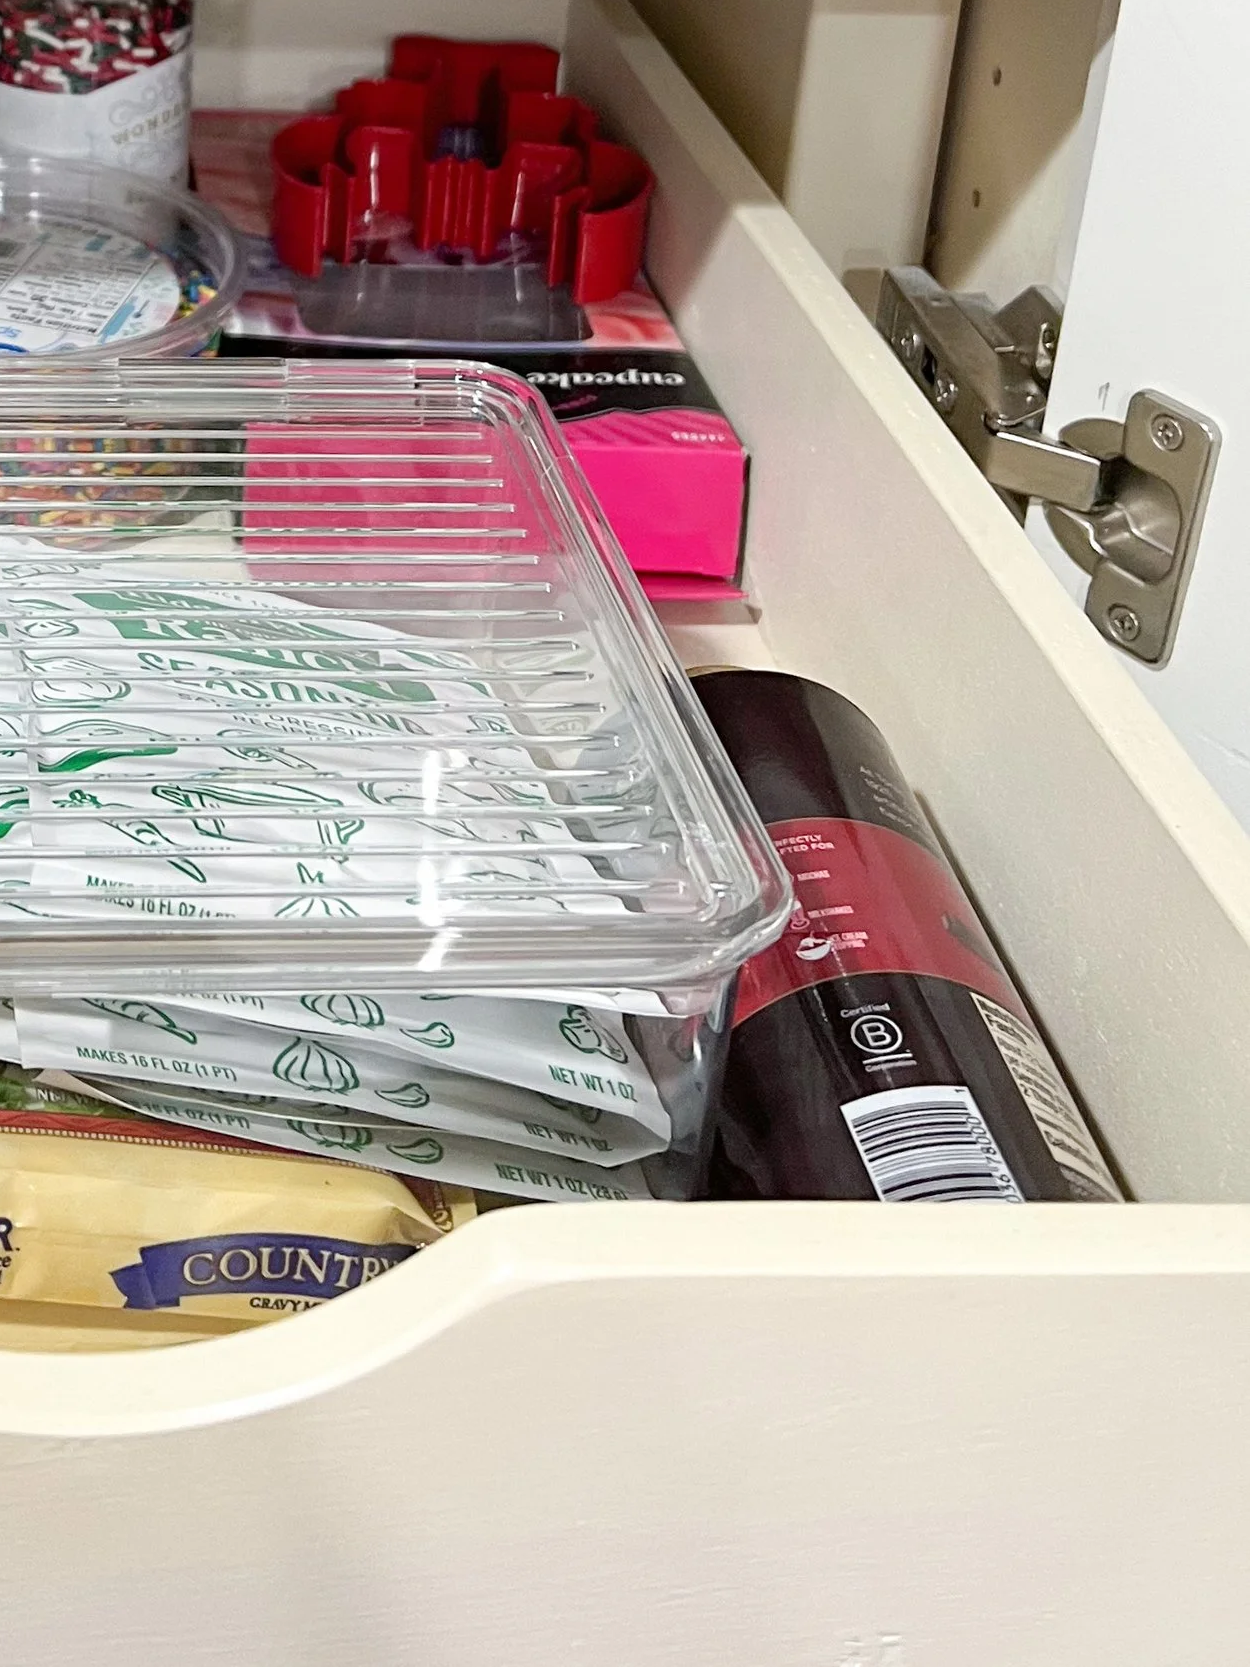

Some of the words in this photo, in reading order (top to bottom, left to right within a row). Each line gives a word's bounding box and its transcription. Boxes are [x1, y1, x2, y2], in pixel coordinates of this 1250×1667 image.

[525, 368, 687, 391] cupcake
[811, 842, 835, 851] FOR
[861, 1022, 892, 1047] B
[76, 1046, 128, 1065] MAKES
[131, 1054, 148, 1068] 16
[151, 1057, 170, 1072] FL
[172, 1059, 193, 1074] OZ
[211, 1066, 238, 1082] PT)
[549, 1064, 577, 1086] NET
[581, 1072, 606, 1094] WT
[609, 1080, 618, 1096] 1
[620, 1084, 638, 1103] OZ
[523, 1121, 551, 1140] NET
[494, 1162, 525, 1183] NET
[527, 1169, 552, 1188] WT
[553, 1175, 563, 1190] 1
[567, 1178, 589, 1195] OZ
[250, 1296, 300, 1312] GRAVY
